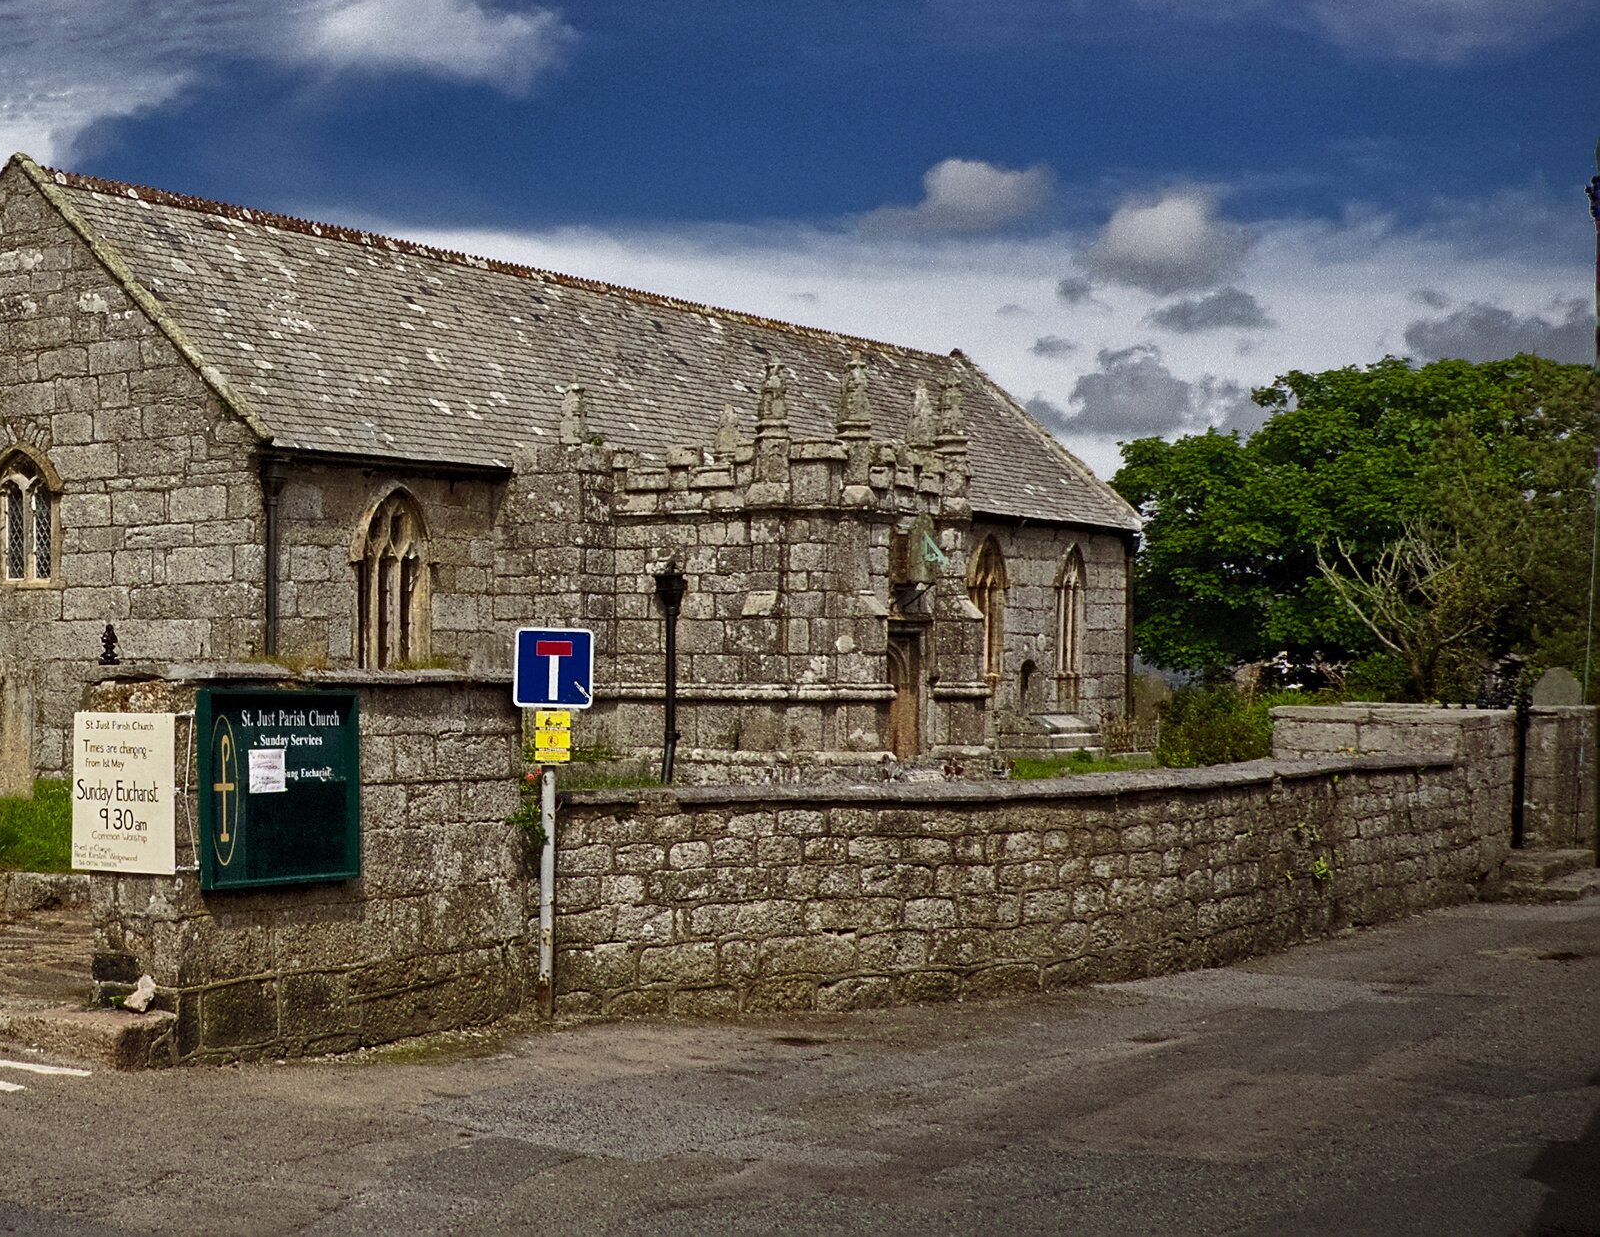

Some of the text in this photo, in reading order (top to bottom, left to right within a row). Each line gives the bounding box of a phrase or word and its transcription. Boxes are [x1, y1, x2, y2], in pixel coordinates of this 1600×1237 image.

[96, 720, 110, 730] Just
[132, 721, 154, 731] Church
[241, 709, 340, 727] St. Just Parish Church
[82, 739, 104, 754] Times
[106, 744, 118, 754] are
[119, 740, 147, 759] changing
[260, 733, 323, 749] Sunday Services
[111, 758, 125, 772] May
[76, 778, 159, 806] Sunday Eucharist
[91, 830, 148, 844] Common Worship
